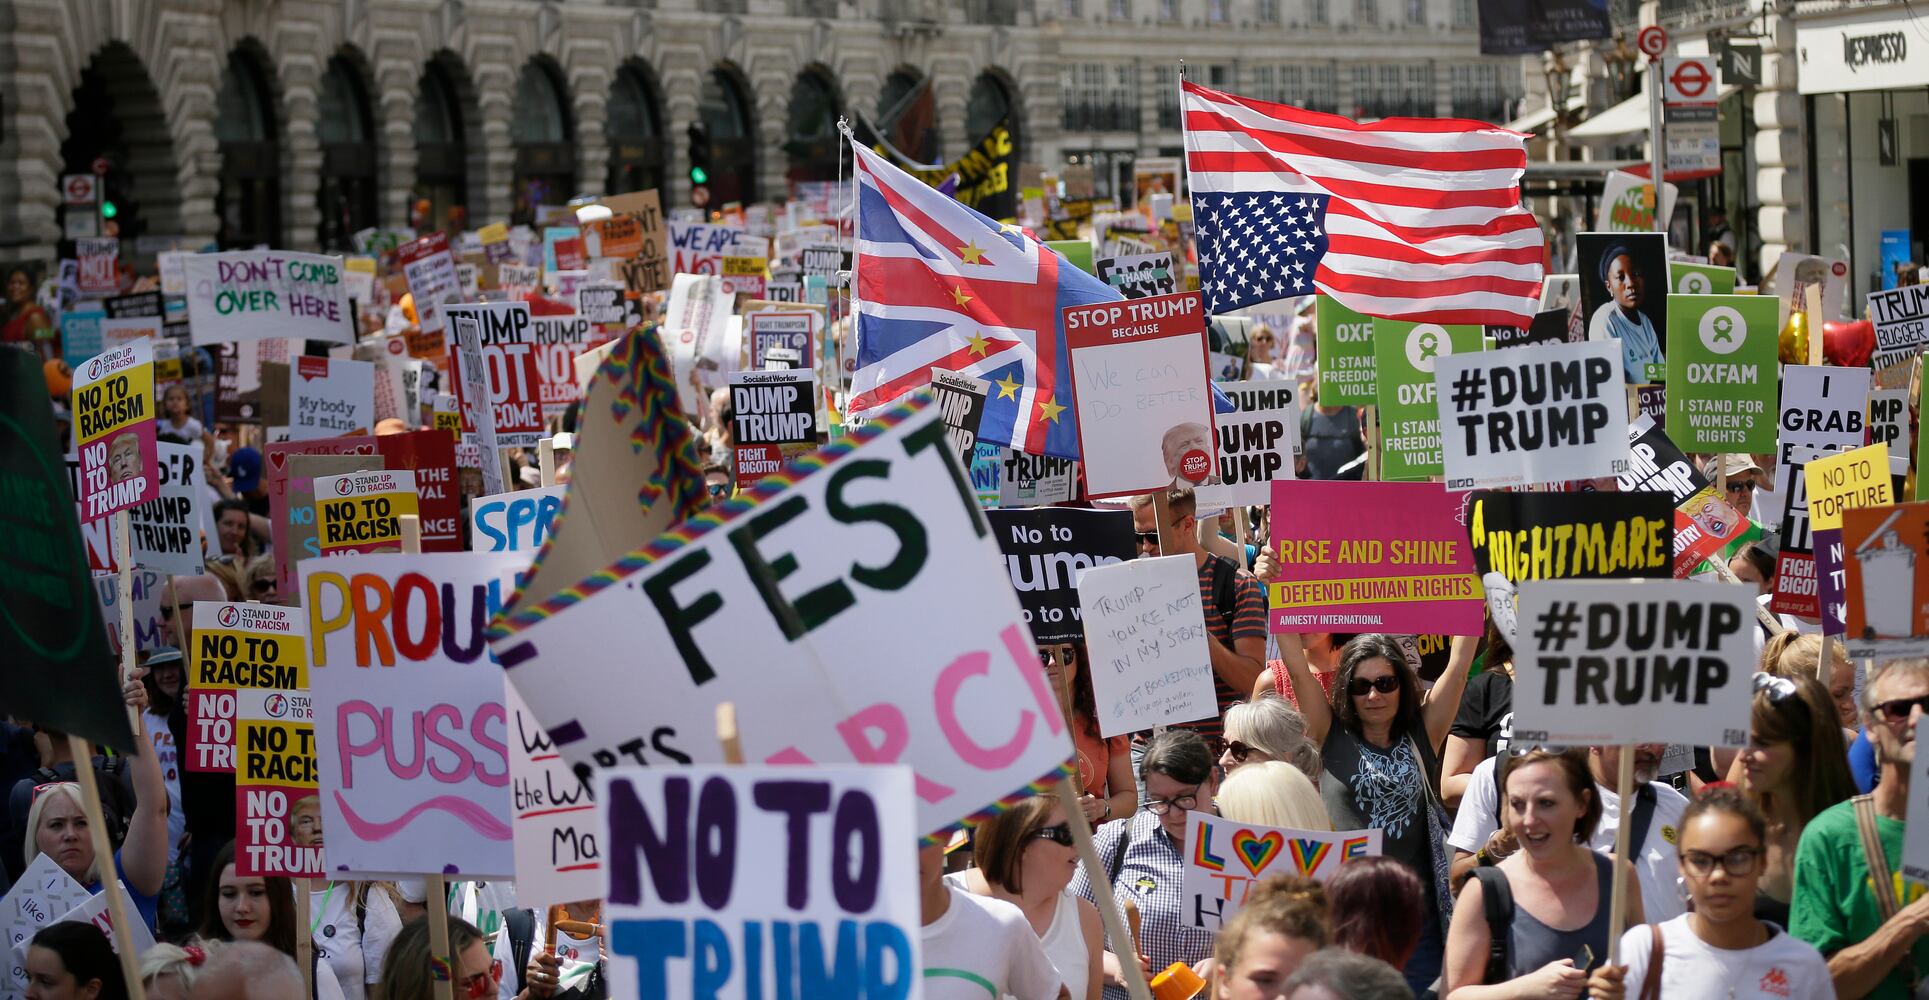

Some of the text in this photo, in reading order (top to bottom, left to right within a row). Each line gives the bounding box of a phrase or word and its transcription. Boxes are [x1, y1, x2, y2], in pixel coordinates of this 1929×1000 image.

[1842, 31, 1907, 73] NESPRESSO
[671, 226, 703, 250] WE
[218, 260, 339, 285] DON'T COMB
[1119, 269, 1153, 284] THANK
[215, 292, 341, 322] OVER HERE
[583, 290, 617, 306] DUMP
[1871, 285, 1929, 321] TRUM
[583, 306, 624, 324] TRUMP
[1068, 296, 1198, 329] STOP TRUMP
[532, 320, 589, 345] RUMP
[1111, 324, 1159, 338] BECAUSE
[1877, 321, 1927, 346] BUGGER
[103, 347, 132, 366] STAND UP
[103, 355, 136, 374] TO RACISM
[1081, 359, 1178, 391] We can
[1452, 357, 1612, 412] #DUMP
[1687, 363, 1758, 385] OXFAM
[78, 375, 128, 415] NO TO
[1136, 387, 1199, 410] BETTER
[1822, 376, 1830, 398] I
[735, 386, 797, 414] DUMP
[1680, 400, 1764, 413] I STAND FOR
[79, 393, 144, 439] RACISM
[299, 412, 356, 430] is mine
[437, 414, 459, 426] SAY
[463, 402, 539, 428] WCOME
[736, 413, 812, 442] TRUMP
[1689, 415, 1754, 428] WOMEN'S
[1782, 408, 1863, 433] GRAB
[1457, 403, 1608, 456] TRUMP
[1696, 430, 1746, 443] RIGHTS
[84, 441, 107, 472] NO
[738, 448, 767, 461] FIGHT
[1184, 462, 1208, 471] TRUMP
[1186, 456, 1205, 464] STOP
[418, 468, 449, 482] THE
[739, 461, 780, 474] BIGOTRY
[1005, 456, 1071, 482] TRUMP
[1823, 460, 1871, 491] NO TO
[87, 468, 107, 495] TO
[355, 475, 392, 486] STAND UP
[368, 482, 396, 492] RACISM
[88, 476, 147, 518] TRUMP
[1813, 483, 1888, 520] TORTURE
[289, 507, 314, 526] NO
[325, 498, 390, 523] NO TO
[1011, 524, 1073, 544] No to
[1471, 499, 1486, 549] A
[133, 524, 192, 554] TRUMP
[1488, 515, 1666, 582] NIGHTMARE
[642, 417, 987, 687] FEST
[1279, 540, 1457, 565] RISE AND SHINE
[1092, 586, 1145, 618] TRUMP
[1281, 577, 1473, 604] DEFEND HUMAN RIGHTS
[242, 609, 285, 620] STAND UP
[1040, 606, 1064, 623] to
[1167, 593, 1195, 617] NOT
[242, 619, 290, 631] TO RACISM
[1279, 614, 1383, 625] AMNESTY INTERNATIONAL
[1534, 602, 1741, 651] #DUMP
[201, 635, 279, 663] NO TO
[200, 660, 297, 690] RACISM
[1112, 655, 1131, 673] IN
[1537, 656, 1729, 706] TRUMP
[198, 694, 236, 718] NO
[291, 708, 304, 717] TO
[197, 719, 232, 743] TO
[248, 726, 288, 752] NO
[247, 791, 288, 818] NO
[515, 778, 542, 811] the
[246, 818, 285, 845] TO
[607, 776, 881, 913] NO TO
[246, 846, 326, 873] TRUM
[21, 898, 45, 923] like
